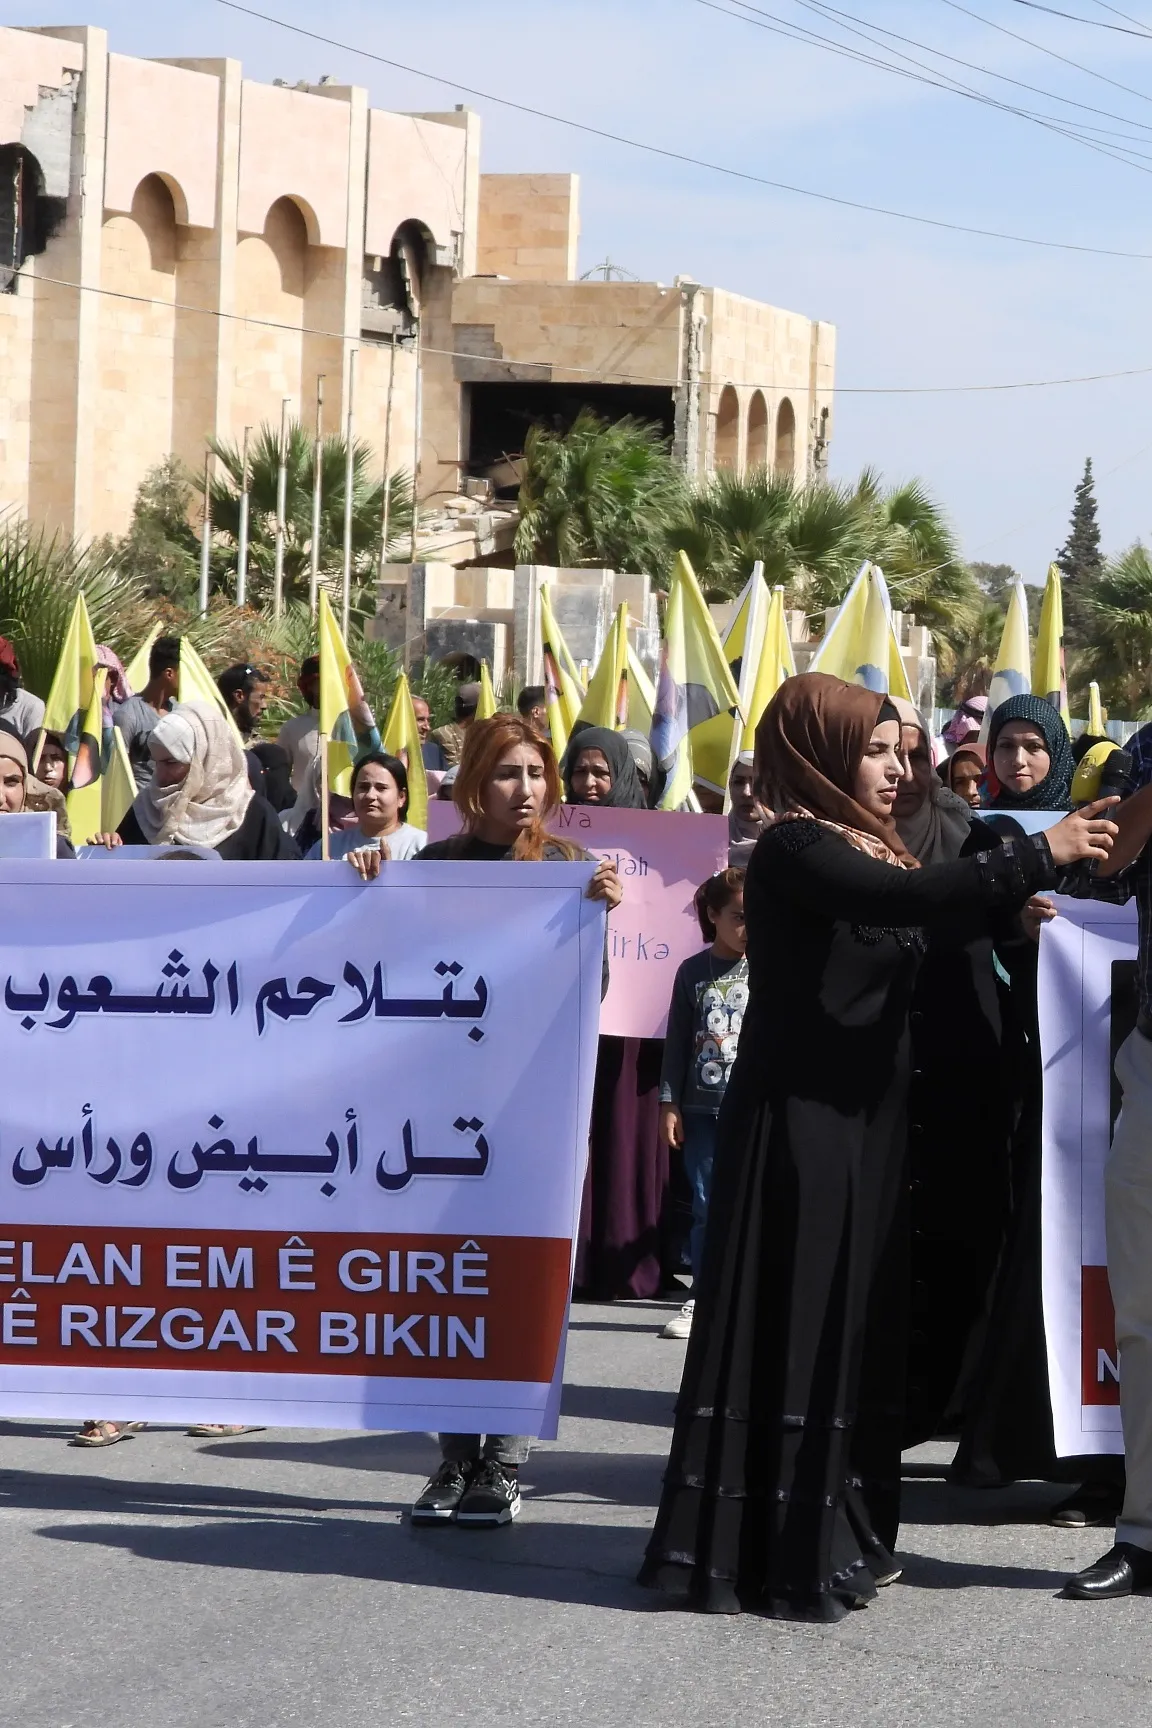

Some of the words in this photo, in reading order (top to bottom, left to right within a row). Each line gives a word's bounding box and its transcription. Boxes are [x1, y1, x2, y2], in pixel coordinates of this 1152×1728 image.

[5, 949, 238, 1030] الشعوب
[256, 961, 487, 1042] بتلاحم
[13, 1103, 152, 1186] ورأس
[168, 1108, 357, 1196] أبيض
[376, 1117, 489, 1190] تل
[167, 1246, 253, 1288] EM
[279, 1236, 315, 1289] Ê
[339, 1240, 488, 1294] GIRÊ
[62, 1305, 298, 1352] RIZGAR
[320, 1312, 484, 1357] BIKIN
